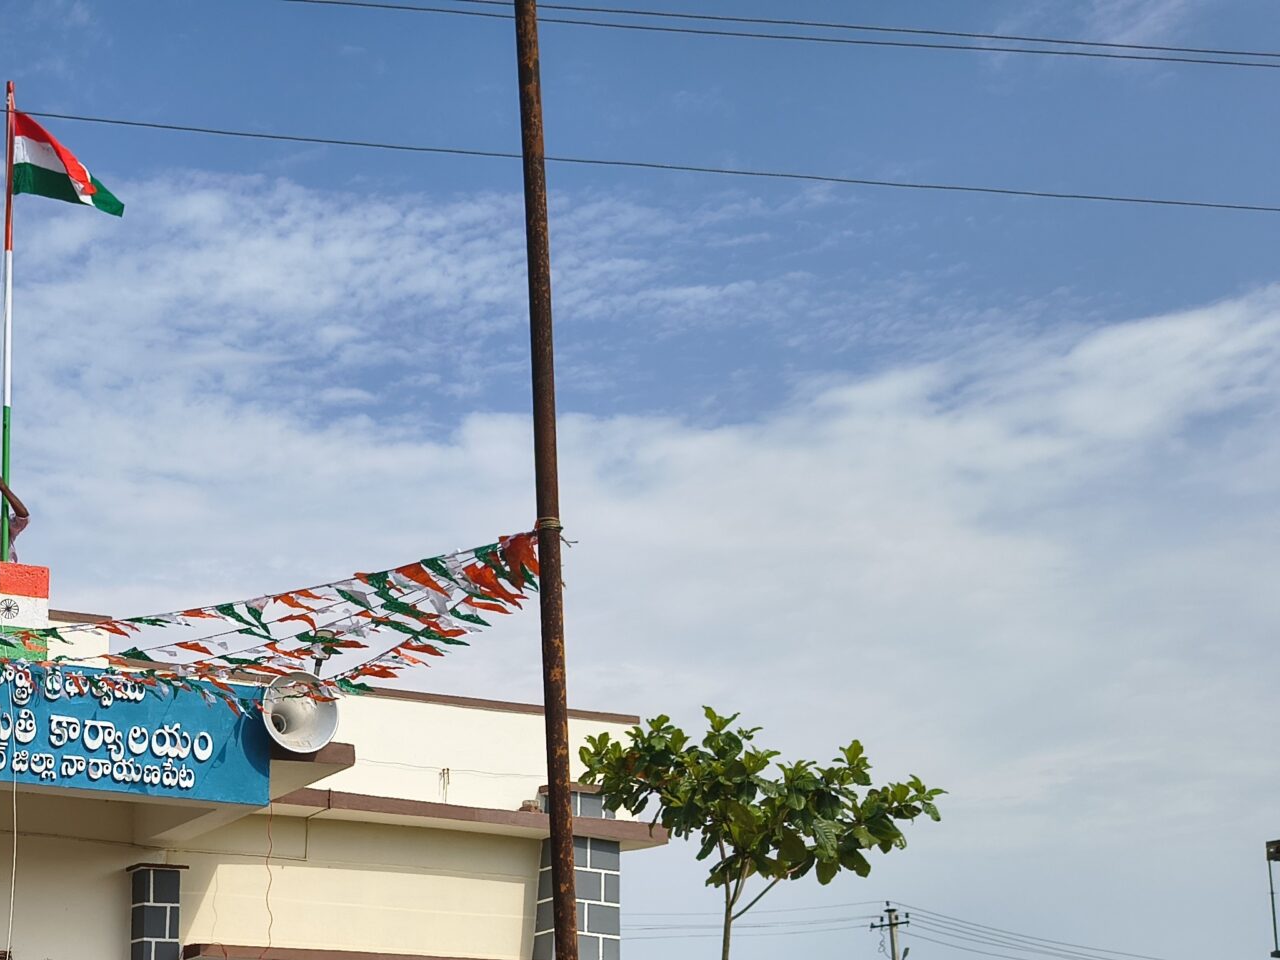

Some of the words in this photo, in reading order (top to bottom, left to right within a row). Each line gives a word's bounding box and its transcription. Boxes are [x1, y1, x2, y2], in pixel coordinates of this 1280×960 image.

[49, 714, 213, 762] కార్యాలయం
[12, 750, 56, 780] జిల్లా
[61, 754, 195, 789] నారాయణపేట
